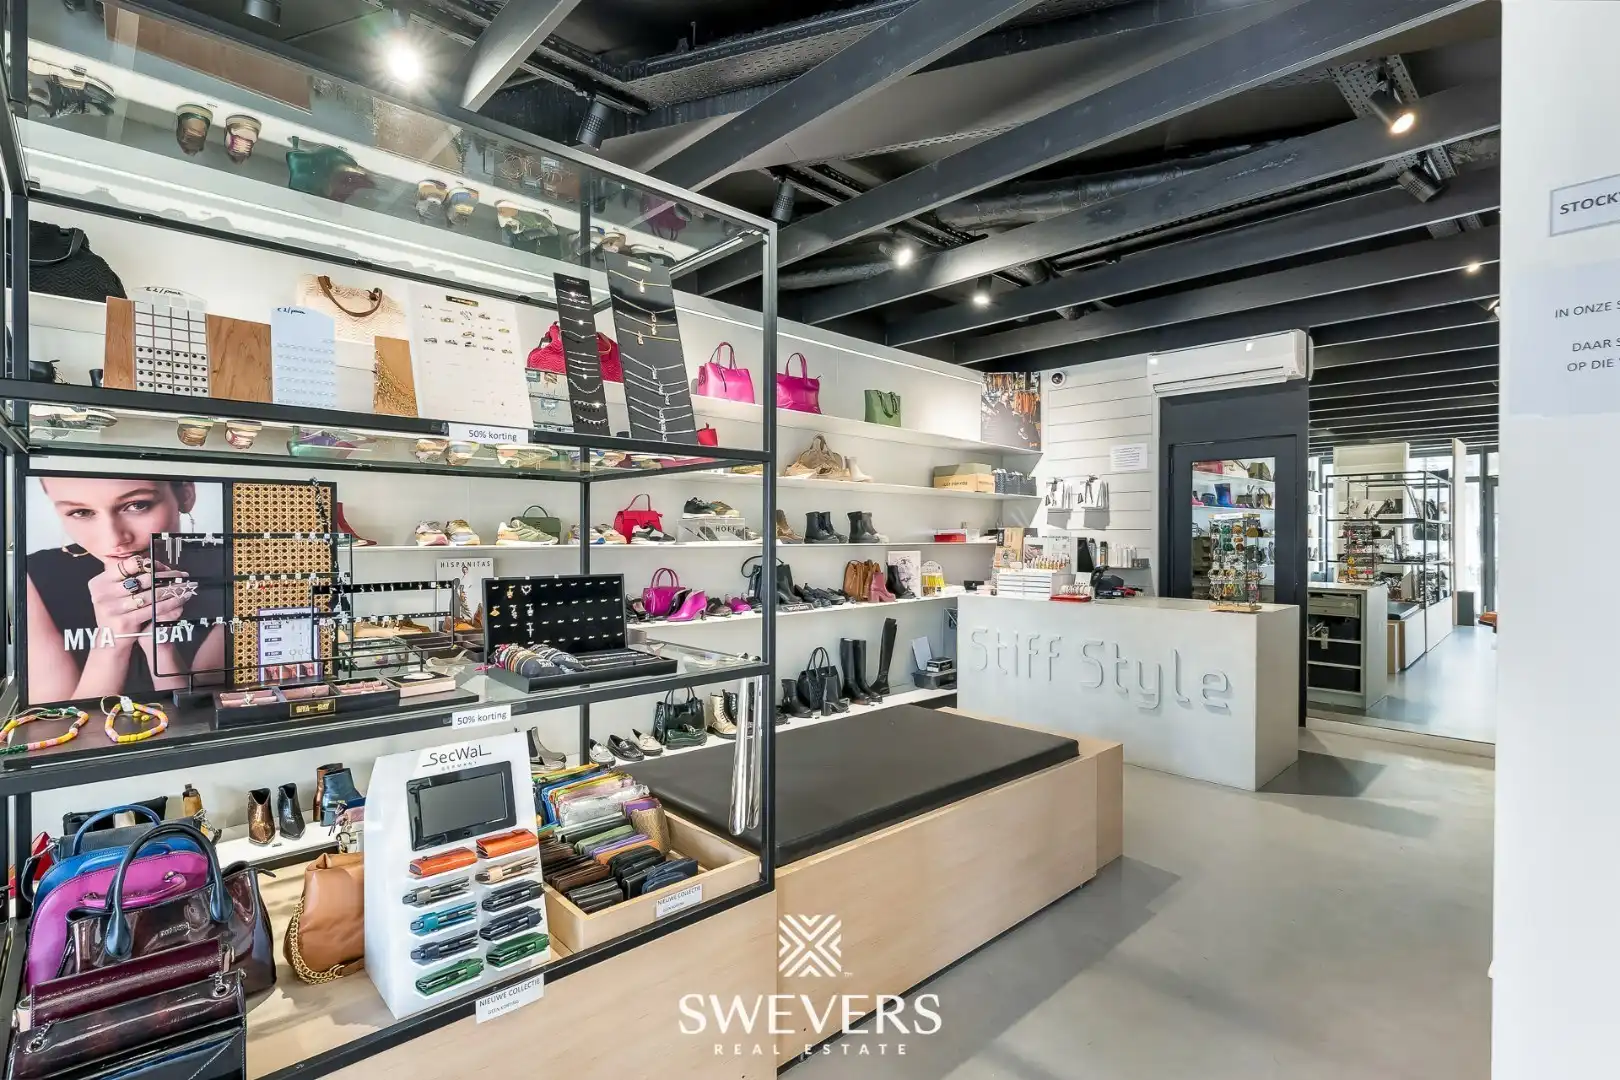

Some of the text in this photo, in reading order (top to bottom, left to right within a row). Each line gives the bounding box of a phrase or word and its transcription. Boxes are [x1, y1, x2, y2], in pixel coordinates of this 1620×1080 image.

[1559, 191, 1620, 215] STOCK
[1555, 308, 1569, 318] IN
[1573, 301, 1613, 316] ONZE
[1572, 338, 1612, 352] DAAR
[1567, 358, 1615, 372] OP DIE
[468, 429, 518, 442] 50% korting
[440, 560, 491, 568] HISPANITAS
[970, 627, 1229, 711] Stiff Style
[457, 711, 508, 726] 50% korting
[479, 977, 541, 1007] NIEUWE COLLECTIE
